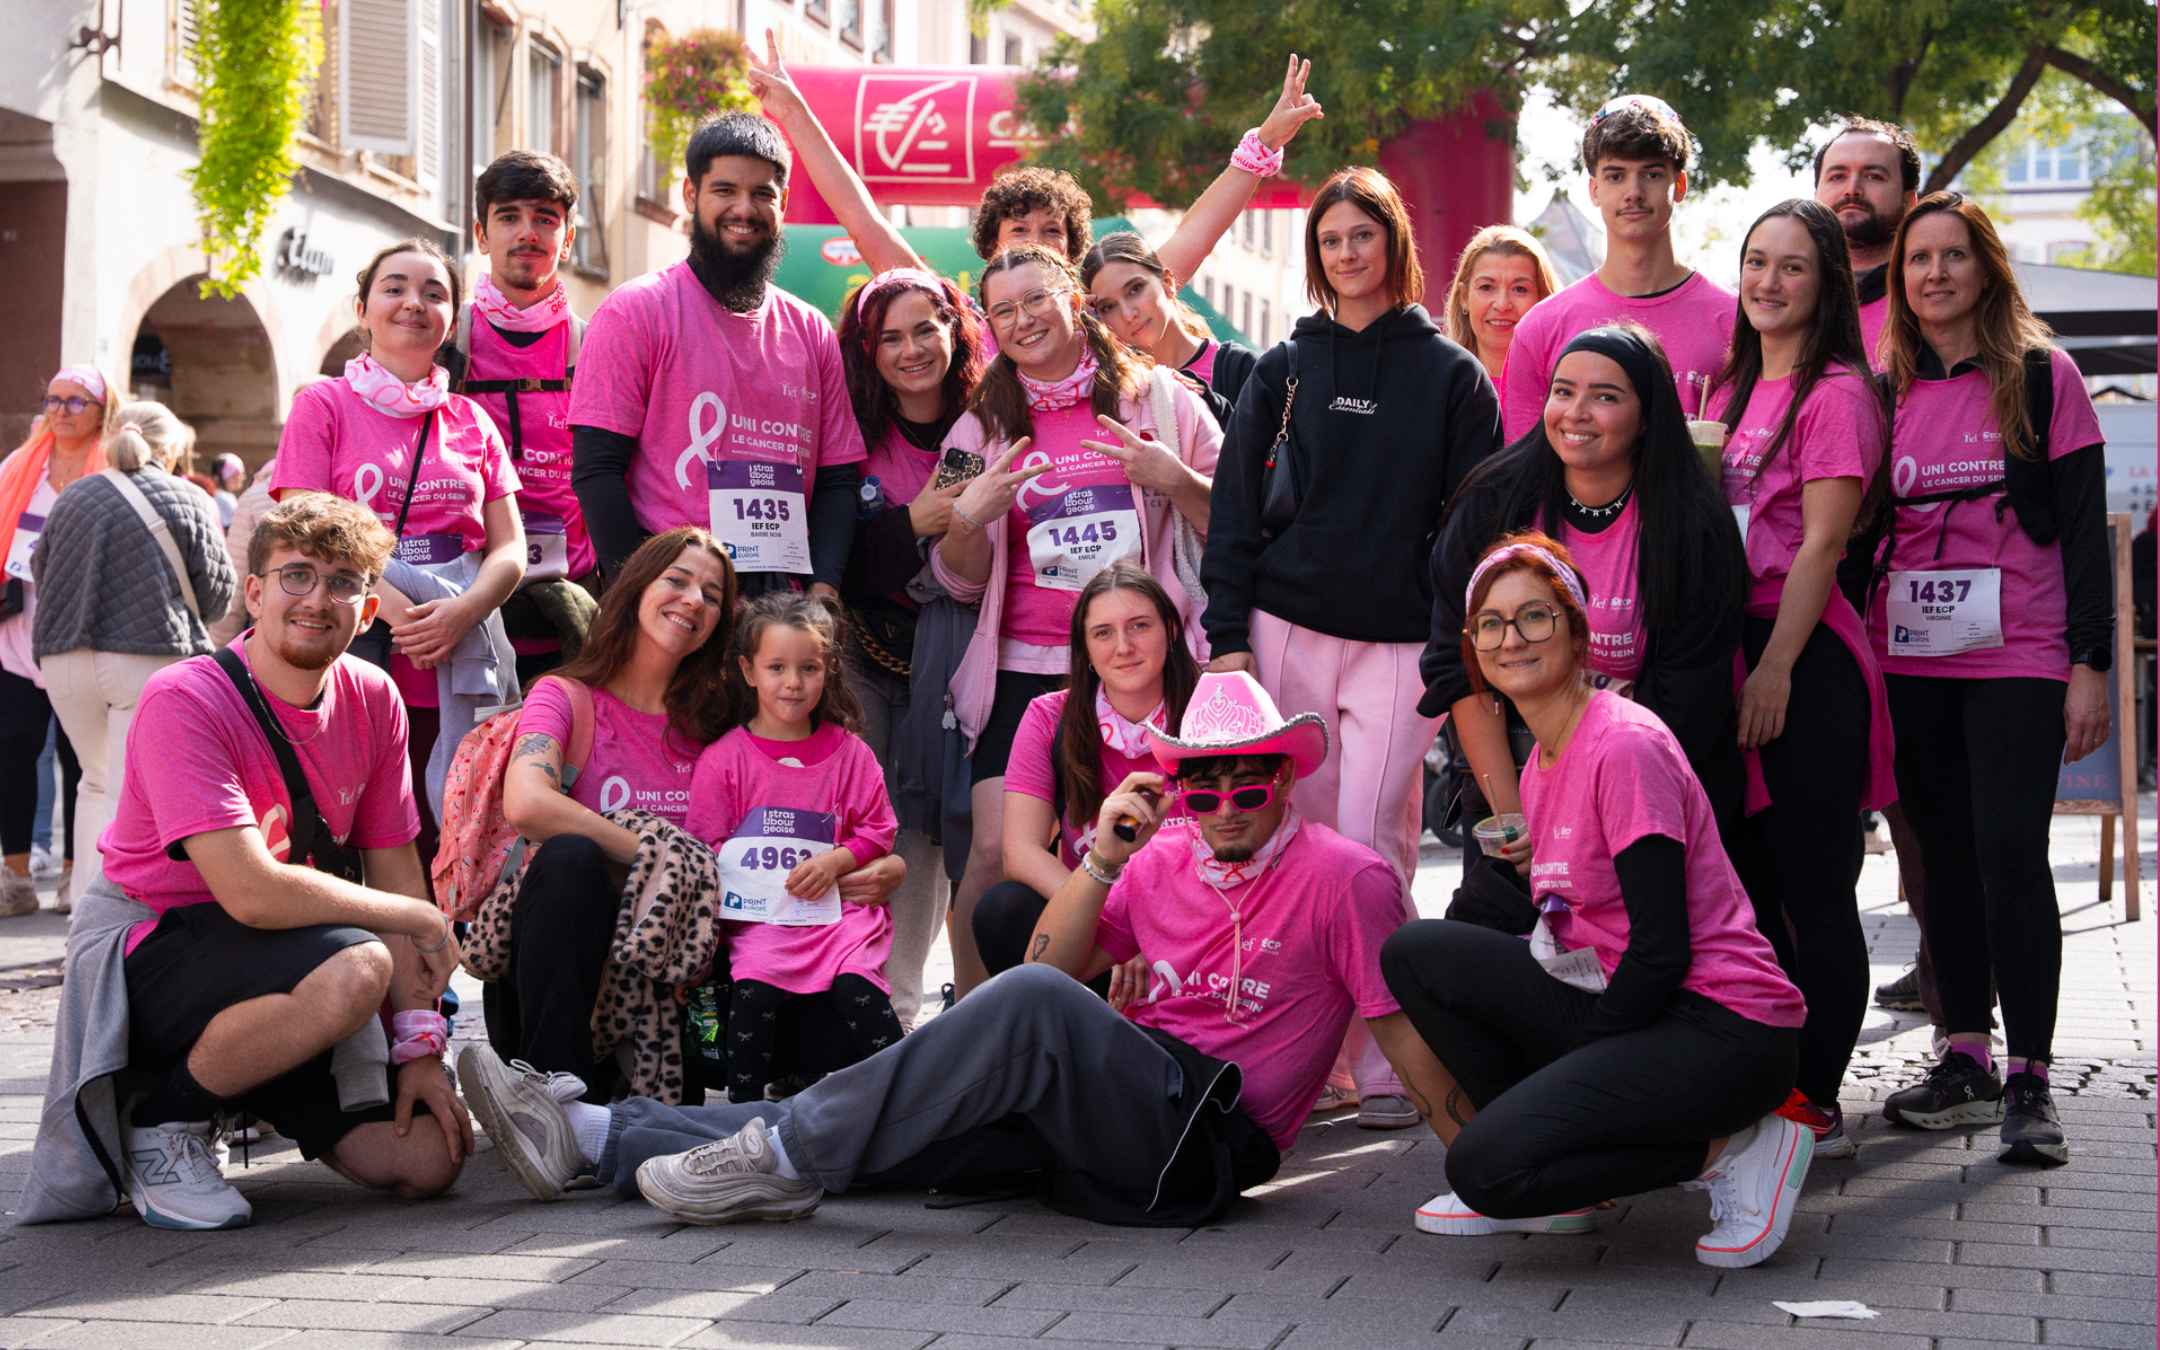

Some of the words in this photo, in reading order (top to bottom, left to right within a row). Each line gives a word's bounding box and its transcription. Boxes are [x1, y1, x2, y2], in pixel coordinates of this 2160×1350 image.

[1336, 397, 1370, 408] DAILY
[731, 414, 756, 433] UNI
[731, 434, 745, 445] LE
[747, 436, 784, 452] CANCER
[1055, 454, 1079, 465] UNI
[1070, 461, 1105, 472] CANCER
[1107, 459, 1121, 467] DU
[1922, 464, 1945, 476] UNI
[1948, 460, 2005, 474] CONTRE
[1934, 476, 1971, 487] CANCER
[1972, 475, 1987, 483] DU
[733, 498, 790, 521] 1435
[1570, 498, 1623, 517] SARAH
[765, 522, 780, 531] ECP
[1048, 520, 1117, 546] 1445
[528, 544, 542, 565] 3
[1086, 545, 1102, 554] ECP
[1910, 580, 1971, 603] 1437
[1936, 605, 1955, 614] ECP
[1590, 631, 1632, 646] NTRE
[1593, 648, 1608, 657] DU
[1610, 647, 1635, 658] SEIN
[636, 791, 660, 801] UNI
[769, 810, 795, 819] stras
[763, 826, 795, 834] geoise
